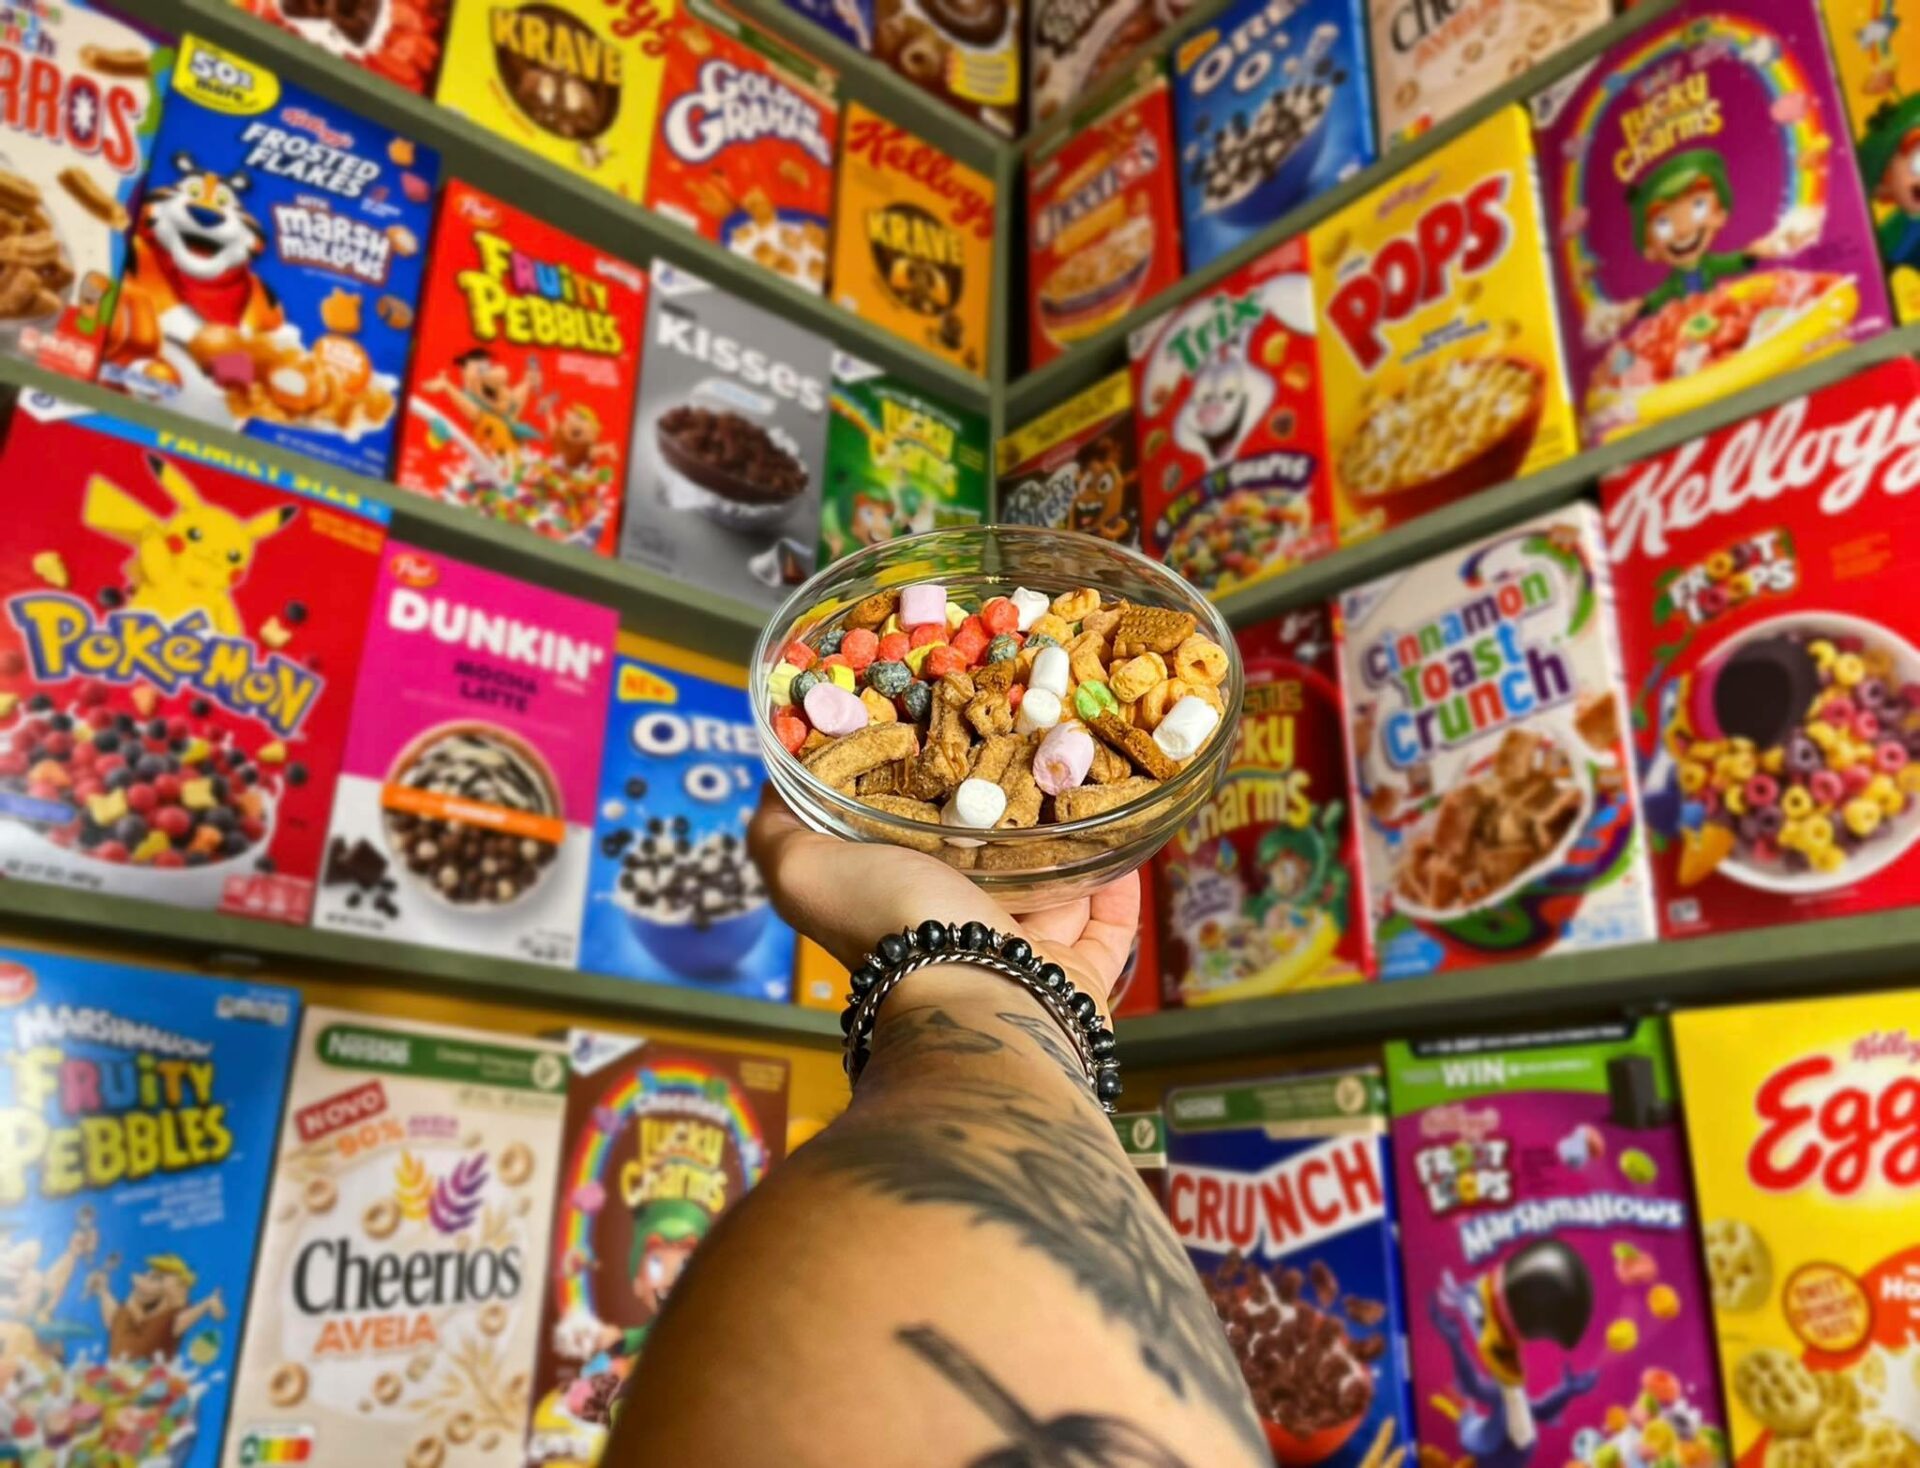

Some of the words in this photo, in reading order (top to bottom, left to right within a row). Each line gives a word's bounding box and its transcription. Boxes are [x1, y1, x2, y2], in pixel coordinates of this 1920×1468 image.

[493, 7, 623, 88] KRAVE
[241, 122, 380, 181] FROSTED
[245, 146, 364, 198] FLAKES
[1325, 173, 1512, 374] POPS
[457, 270, 623, 355] PEBBLES
[1166, 288, 1264, 373] Trix
[388, 588, 604, 681] DUNKIN'
[1442, 1058, 1505, 1087] WIN
[303, 1089, 382, 1135] NOVO
[1170, 1139, 1384, 1248] CRUNCH
[1458, 1192, 1684, 1265] Marshmallows
[292, 1238, 522, 1315] Cheerios
[315, 1312, 437, 1354] AVEIA
